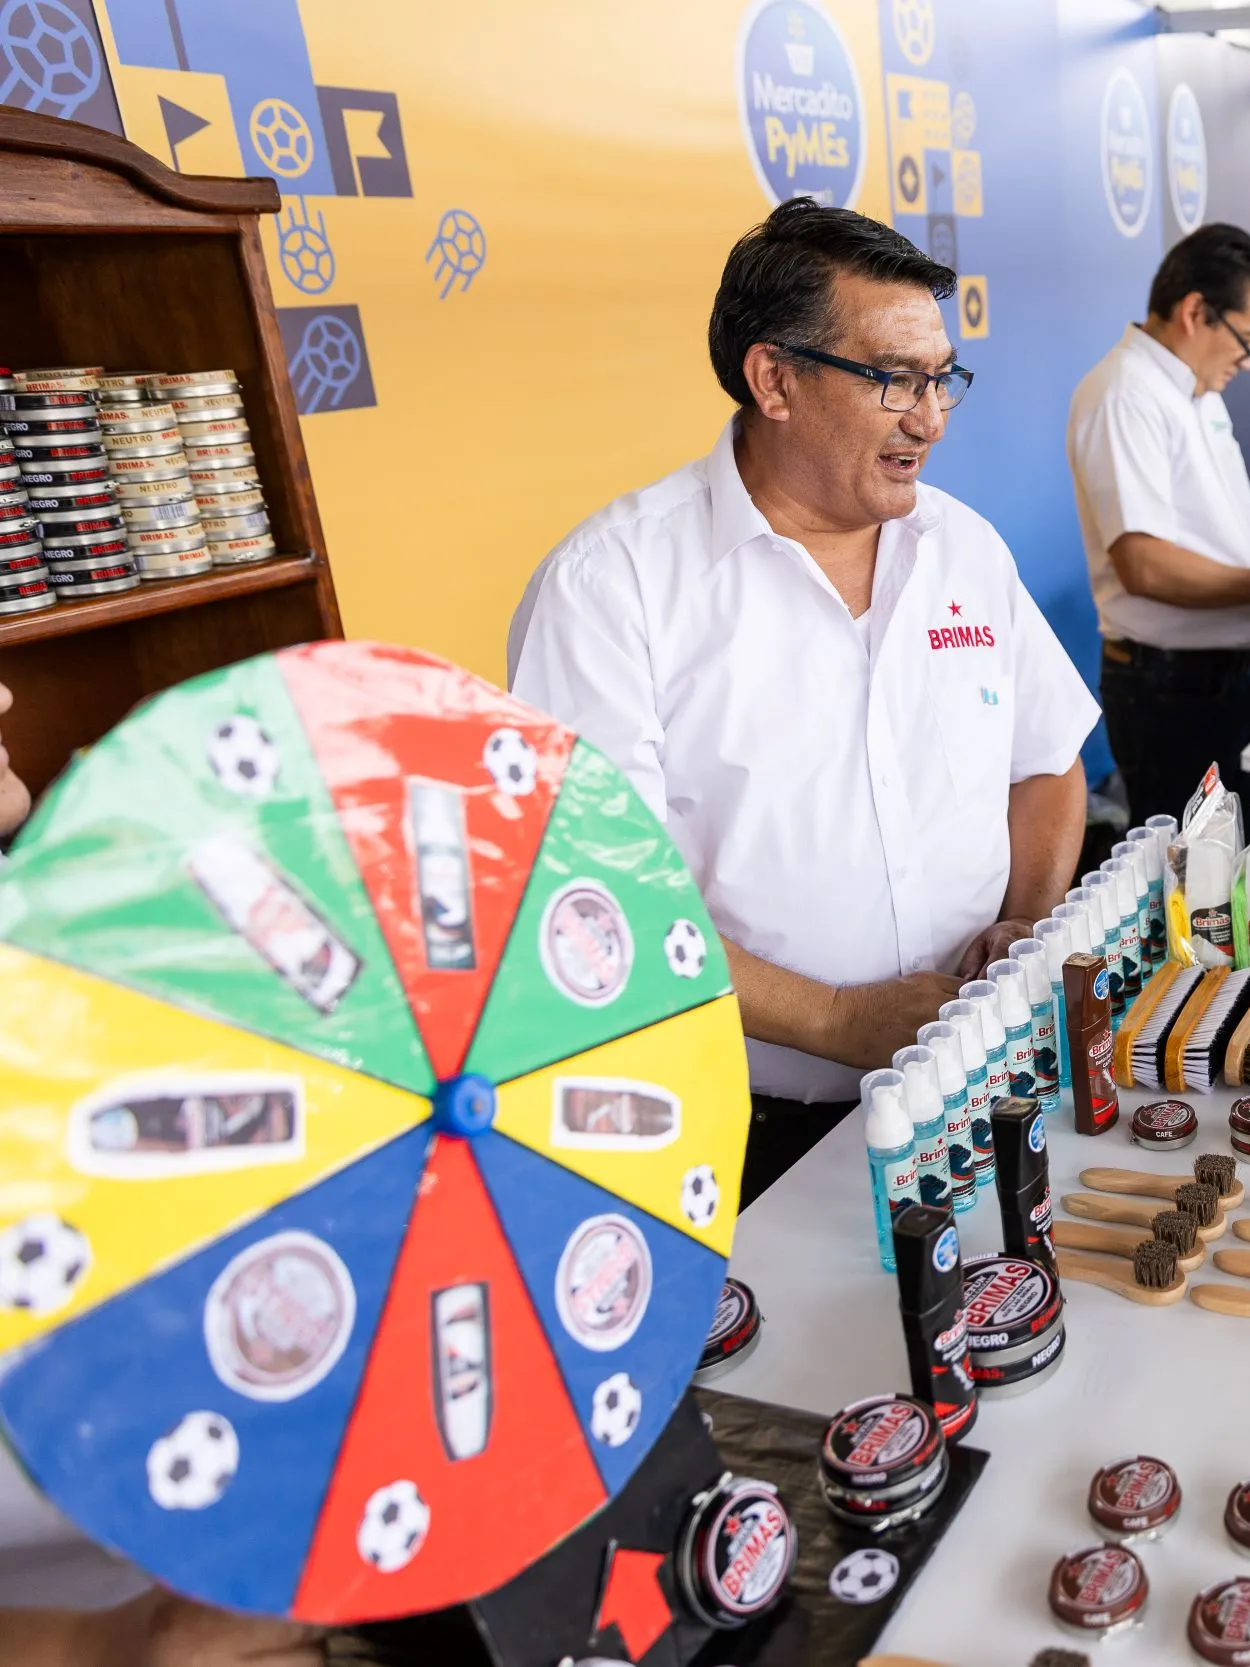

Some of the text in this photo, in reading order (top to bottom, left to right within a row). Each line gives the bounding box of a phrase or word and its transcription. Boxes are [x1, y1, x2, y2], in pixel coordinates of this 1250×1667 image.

[752, 70, 853, 121] Mercadito
[764, 116, 849, 178] PyMEs
[112, 435, 152, 446] NEUTRO
[115, 461, 152, 470] BRIMAS
[140, 533, 175, 542] BRIMAS
[928, 625, 995, 650] BRIMAS
[1152, 1103, 1182, 1128] BRIMAS
[966, 1264, 1031, 1325] BRIMAS
[1016, 1291, 1038, 1313] NEGRO
[1032, 1334, 1061, 1368] NEGRO
[849, 1406, 913, 1465] BRIMAS
[1118, 1462, 1157, 1510] BRIMAS
[722, 1509, 781, 1598] BRIMAS
[1080, 1551, 1124, 1603] BRIMAS
